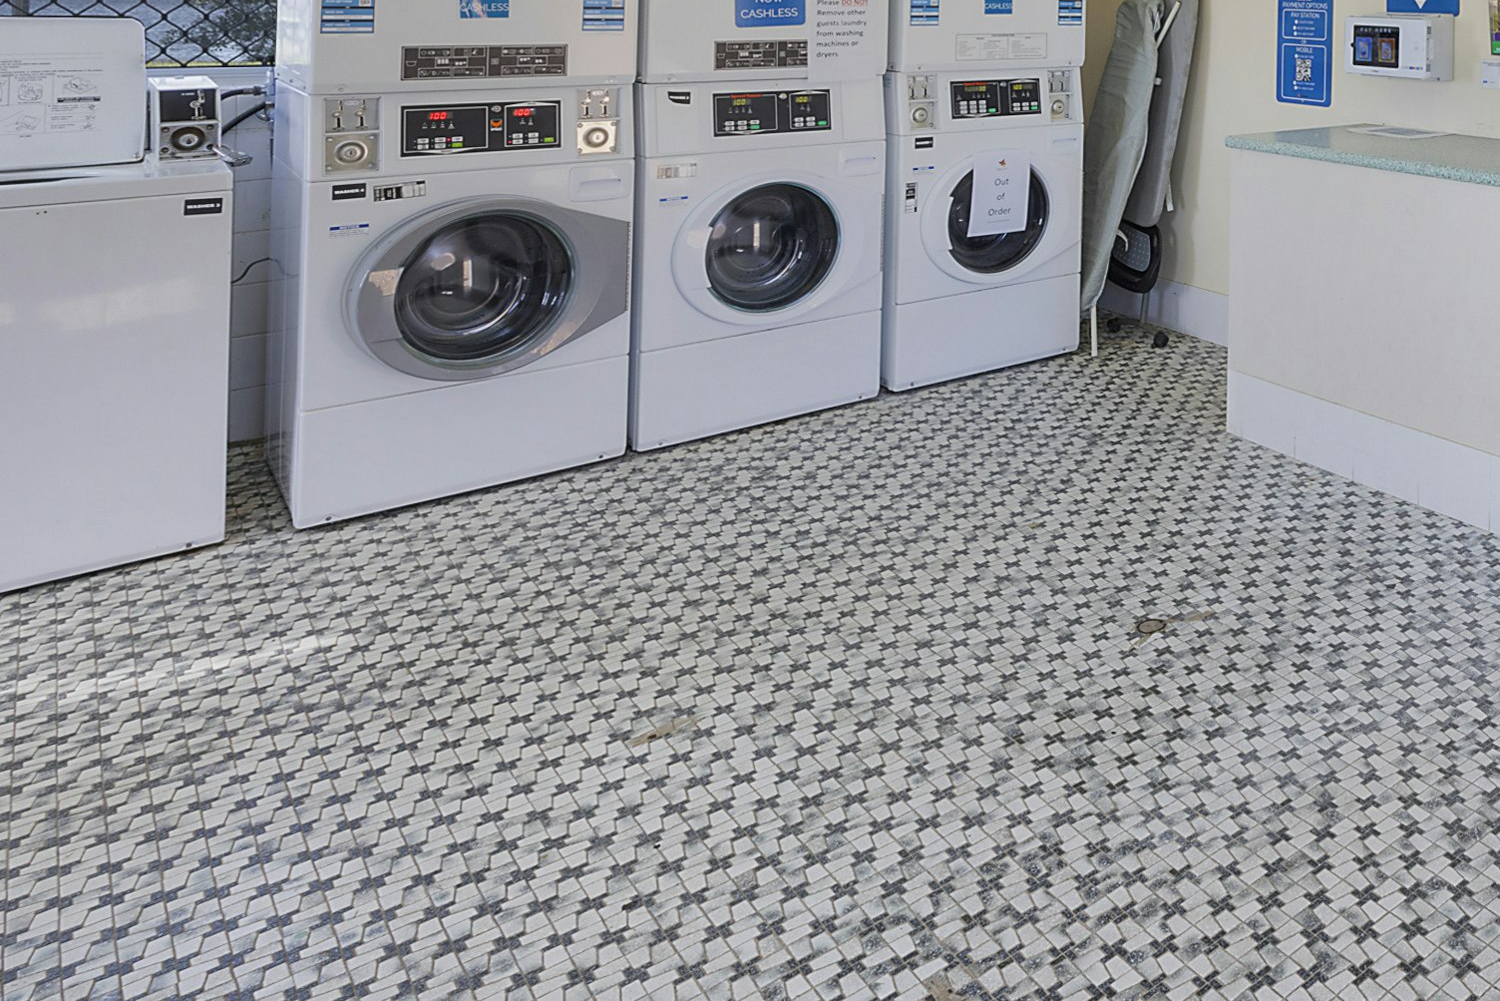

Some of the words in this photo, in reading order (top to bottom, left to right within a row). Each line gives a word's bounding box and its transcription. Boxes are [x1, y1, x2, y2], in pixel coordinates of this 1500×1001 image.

[460, 2, 509, 12] CASHLESS
[740, 8, 798, 19] CASHLESS
[988, 208, 1011, 216] Order
